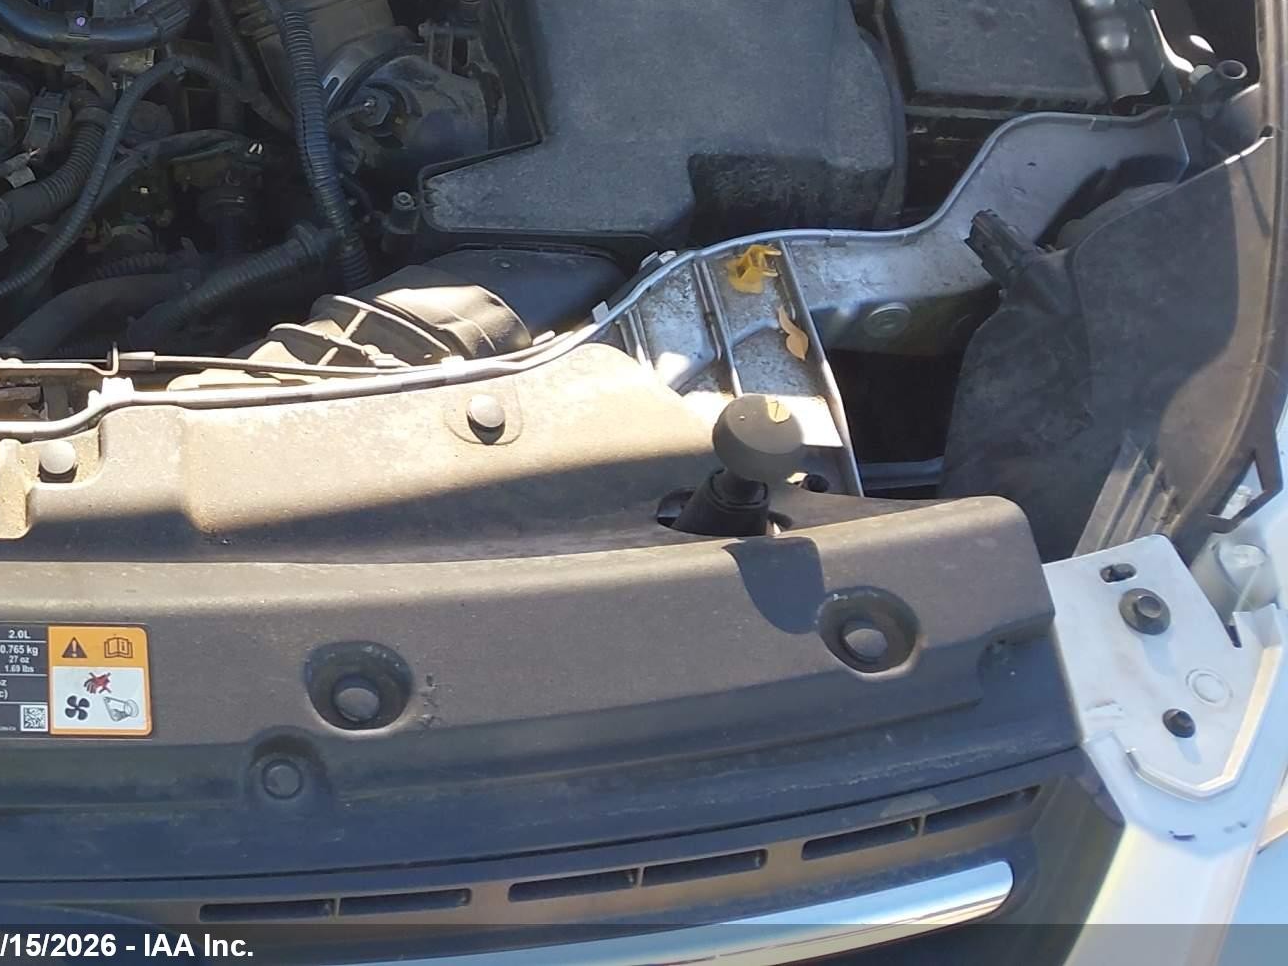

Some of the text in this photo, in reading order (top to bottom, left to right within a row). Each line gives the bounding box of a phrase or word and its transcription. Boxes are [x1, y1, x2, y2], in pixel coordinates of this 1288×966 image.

[8, 630, 31, 639] 2.0L
[0, 644, 38, 656] 0.765 kg
[22, 665, 34, 673] lbs
